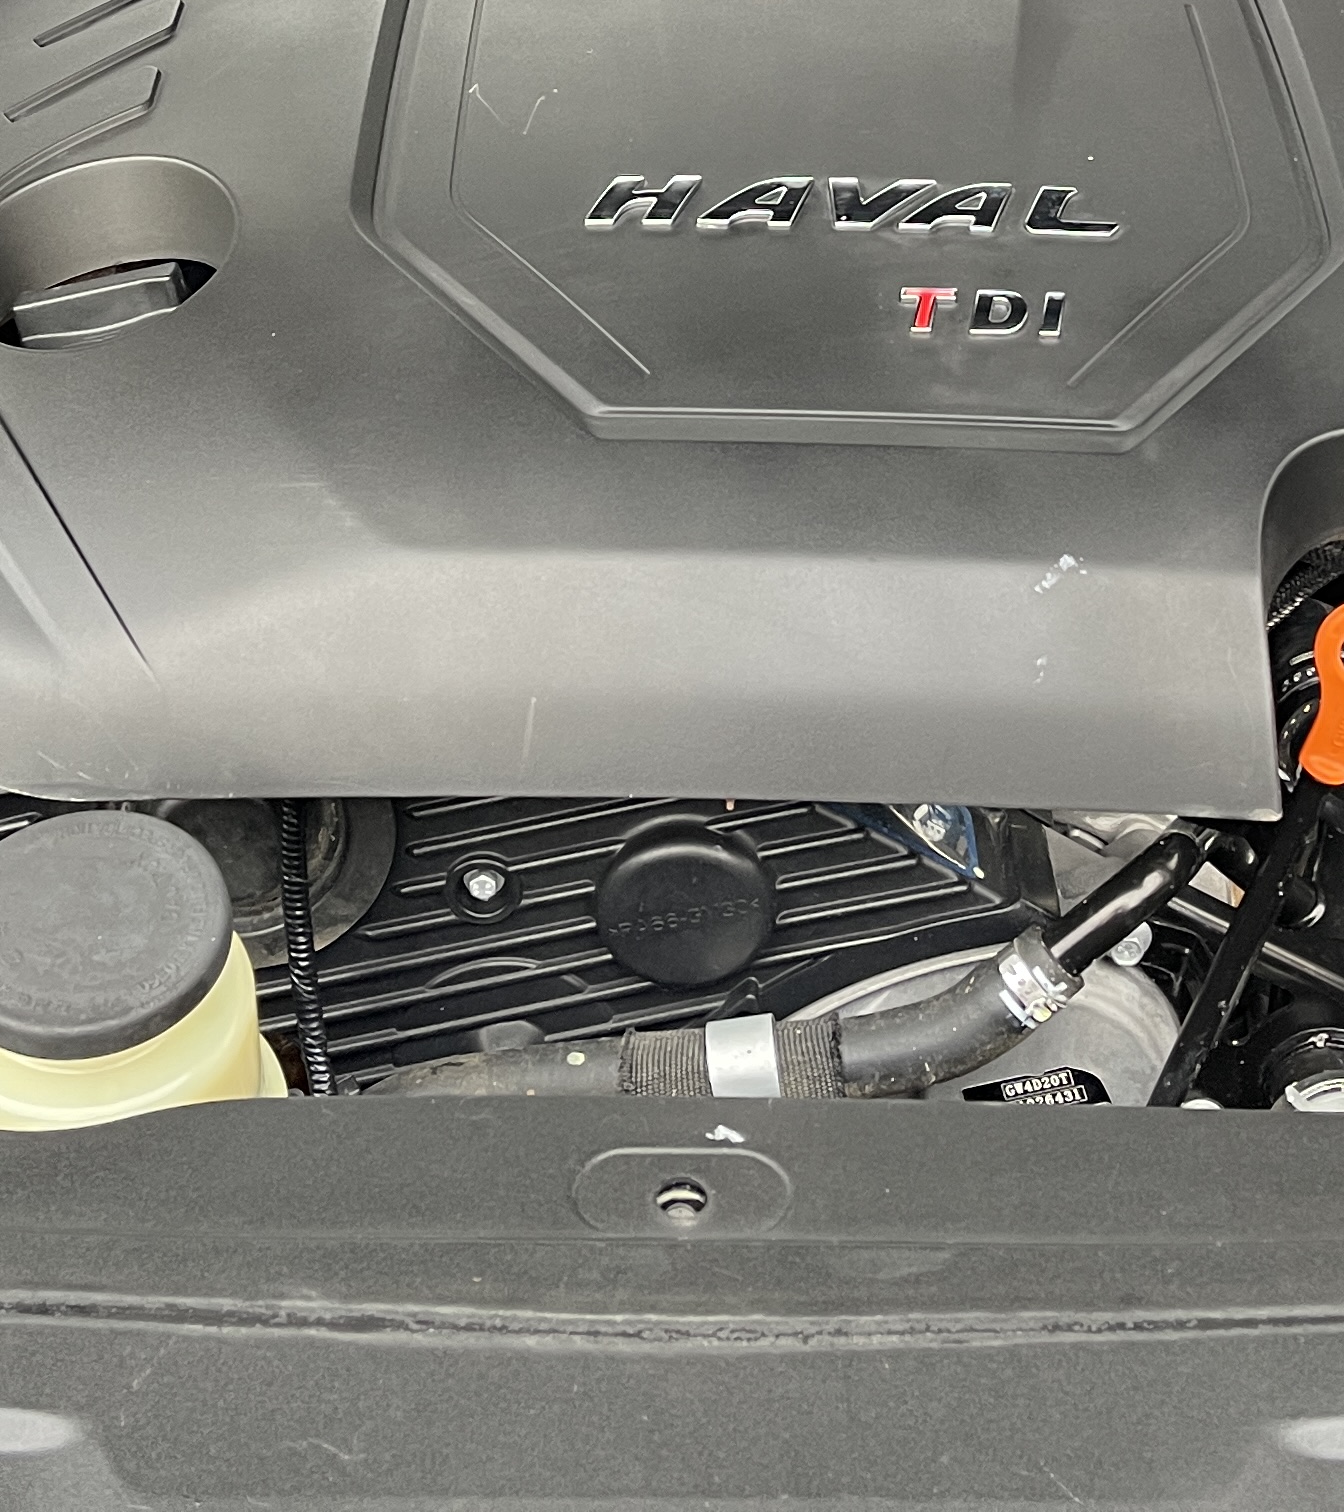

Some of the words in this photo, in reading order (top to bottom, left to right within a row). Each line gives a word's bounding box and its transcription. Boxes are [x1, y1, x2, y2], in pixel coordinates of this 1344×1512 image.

[582, 173, 1120, 238] HAVAL
[899, 285, 1067, 340] TDI
[1005, 1072, 1068, 1096] GW4D20T
